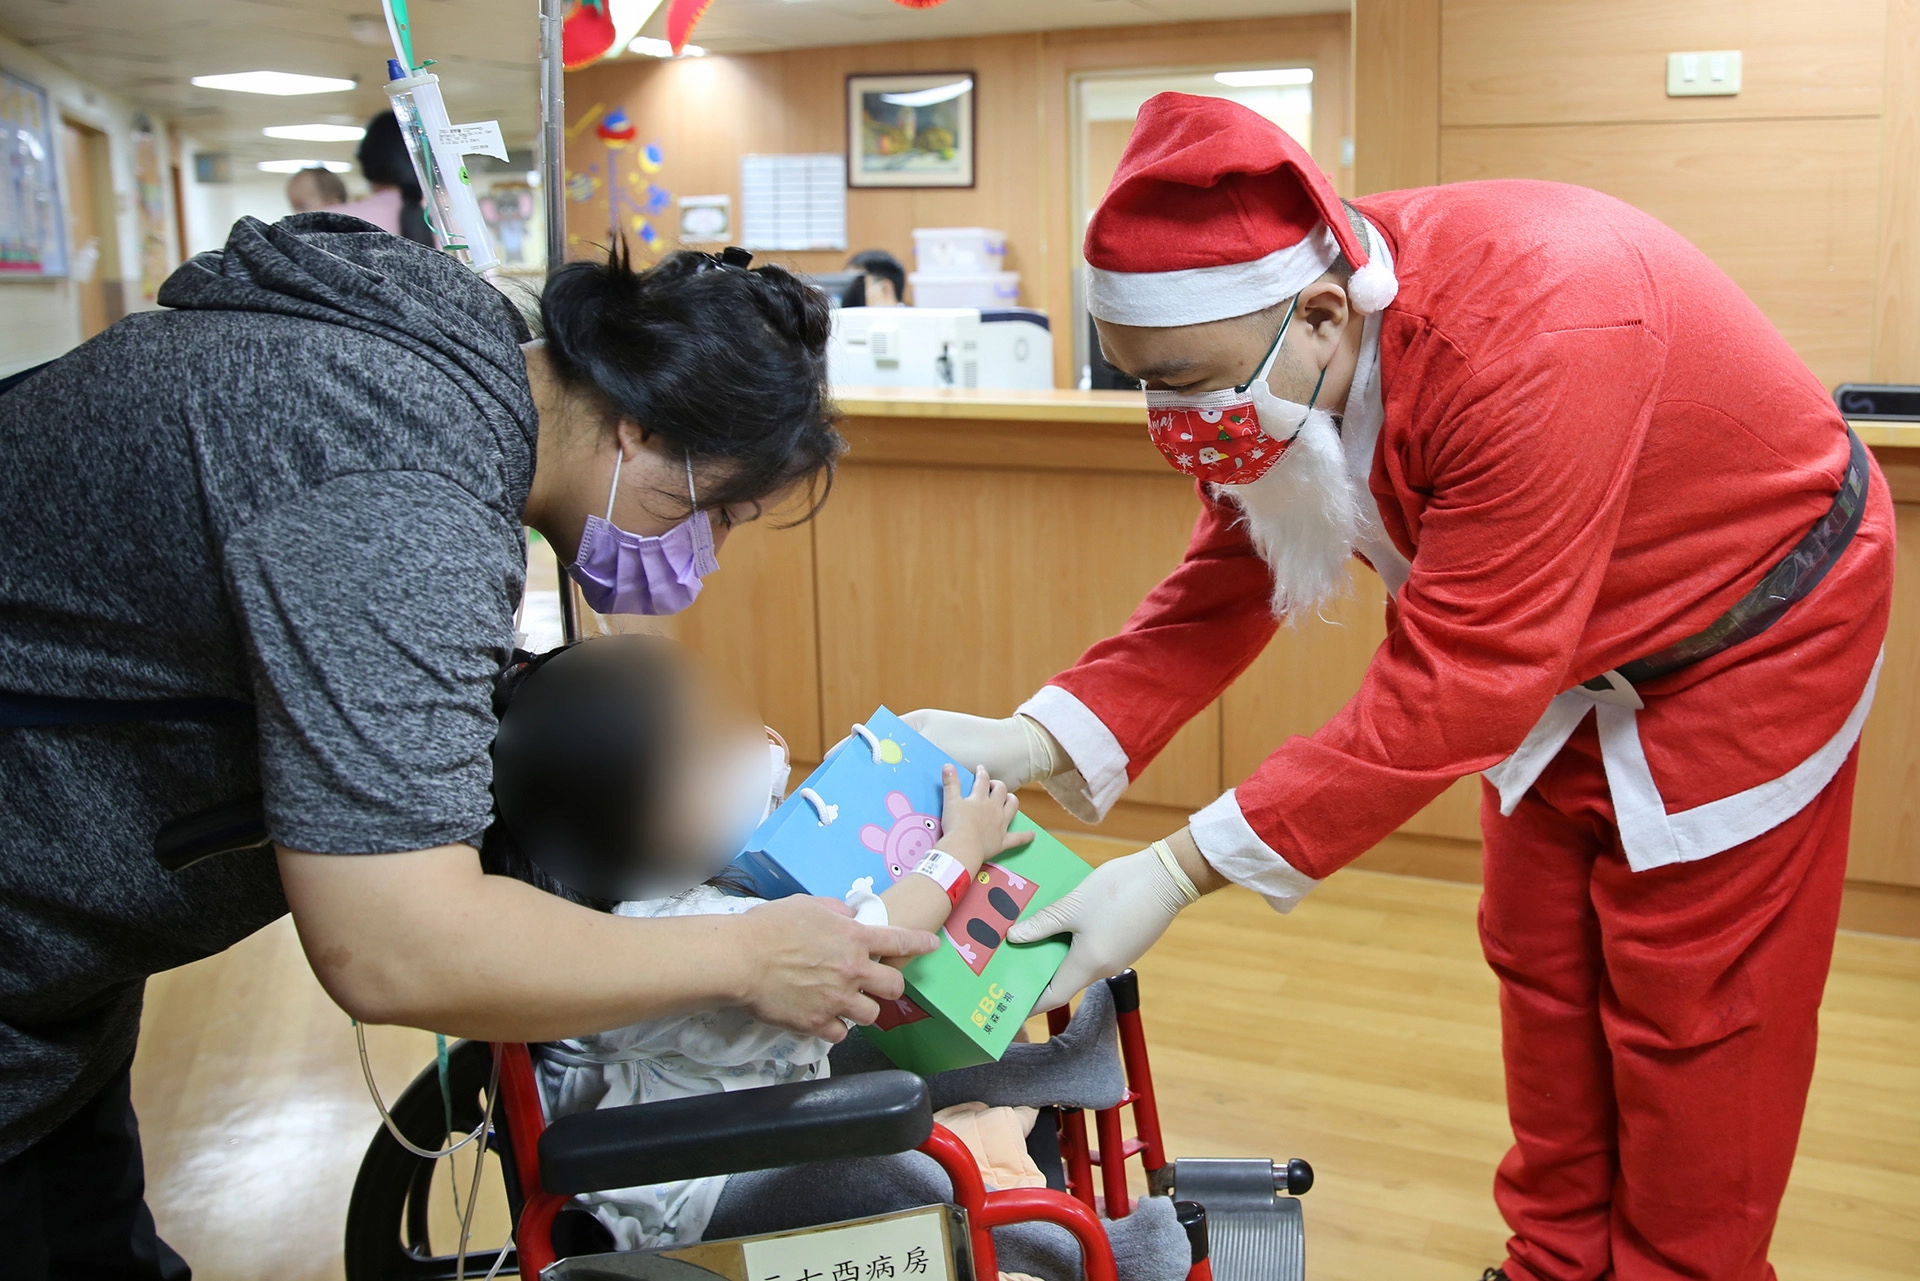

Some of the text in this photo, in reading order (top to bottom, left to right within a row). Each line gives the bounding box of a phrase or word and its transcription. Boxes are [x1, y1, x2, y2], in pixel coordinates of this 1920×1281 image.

[971, 983, 1005, 1028] EBC
[983, 992, 1014, 1035] 東森電視
[763, 1246, 929, 1281] 西病房
